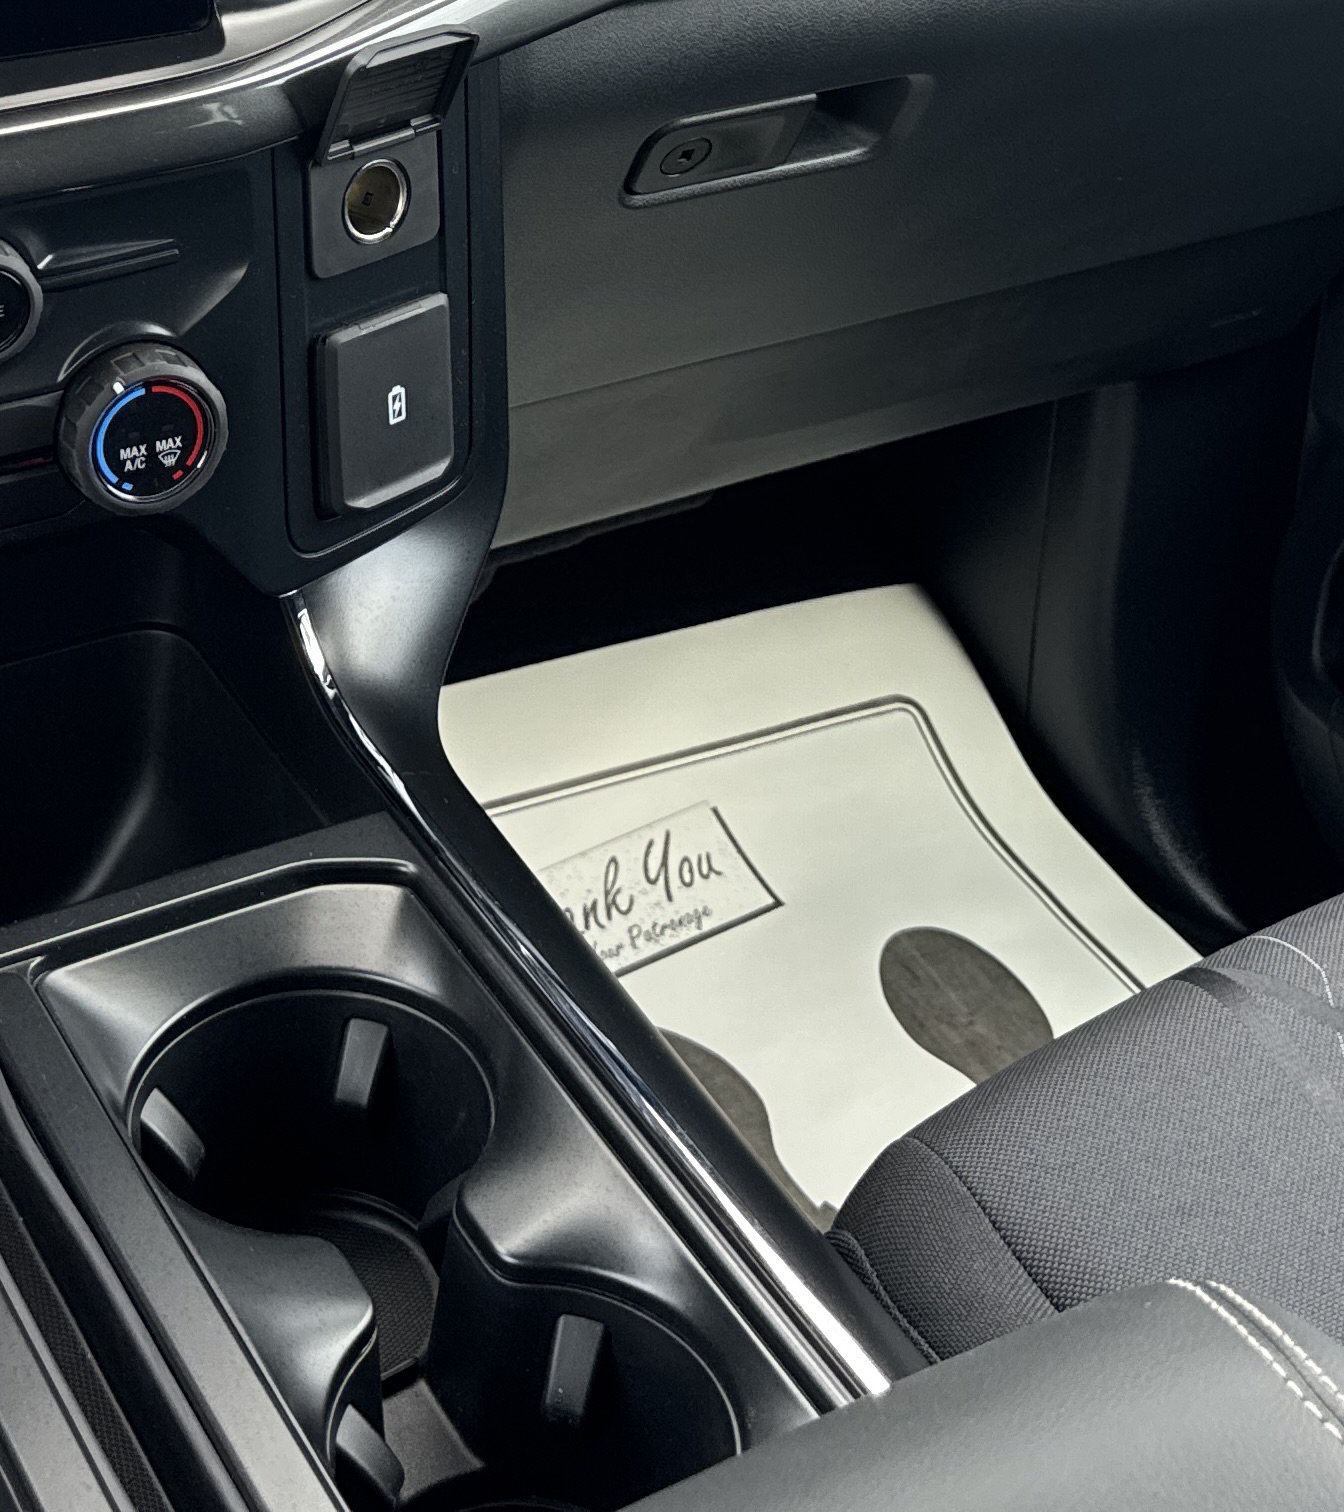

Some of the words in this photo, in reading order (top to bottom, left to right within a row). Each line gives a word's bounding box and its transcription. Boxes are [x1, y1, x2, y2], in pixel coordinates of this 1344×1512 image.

[156, 436, 183, 452] MAX
[119, 445, 147, 460] MAX
[124, 456, 146, 472] A/C
[562, 856, 634, 934] ank
[644, 829, 723, 903] You
[628, 903, 714, 950] Patronage
